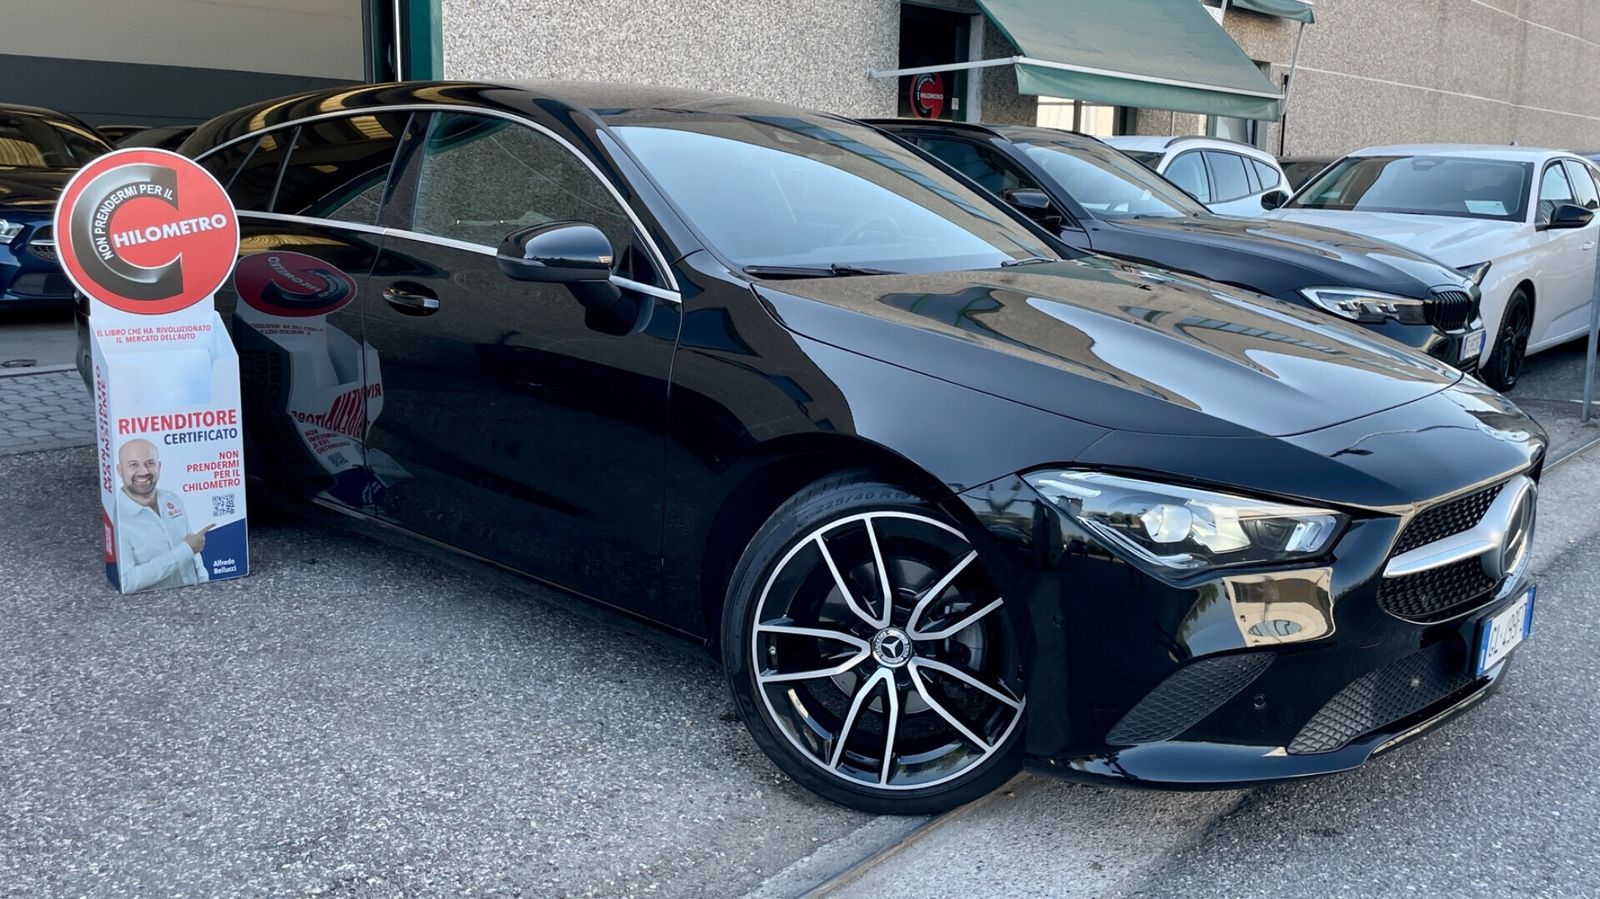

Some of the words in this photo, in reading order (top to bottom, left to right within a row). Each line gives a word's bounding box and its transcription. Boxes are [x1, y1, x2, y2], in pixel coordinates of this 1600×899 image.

[139, 184, 162, 195] PER
[163, 188, 173, 200] IL
[94, 185, 138, 235] PRENDERMI
[95, 236, 114, 261] NON
[105, 328, 127, 337] LIBRO
[156, 324, 211, 333] RIVOLUZIONATO
[126, 335, 159, 343] MERCATO
[160, 333, 196, 341] DELL'AUTO
[117, 409, 237, 435] RIVENDITORE
[164, 428, 238, 445] CERTIFICATO
[219, 450, 239, 460] NON
[187, 460, 240, 473] PRENDERMI
[214, 470, 231, 479] PER
[233, 469, 240, 477] IL
[183, 478, 240, 492] CHILOMETRO
[213, 559, 235, 568] Alfredo
[213, 566, 237, 575] Bellucci
